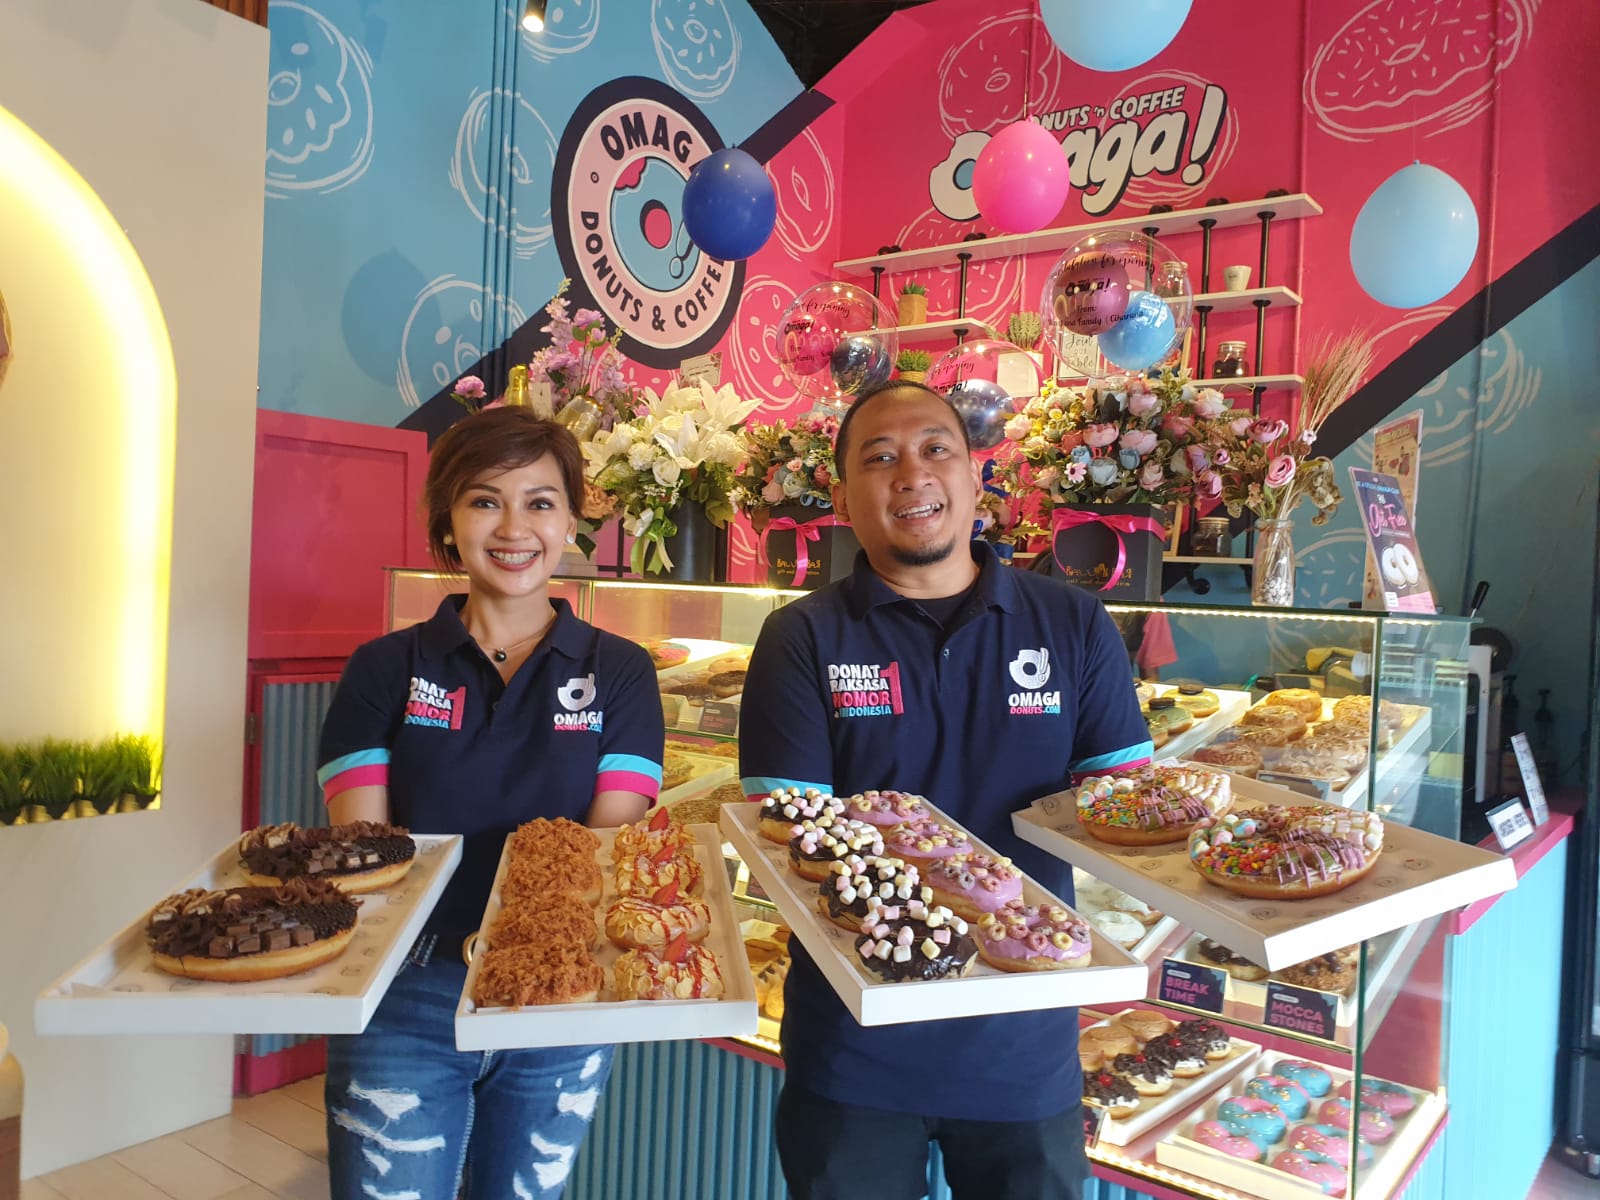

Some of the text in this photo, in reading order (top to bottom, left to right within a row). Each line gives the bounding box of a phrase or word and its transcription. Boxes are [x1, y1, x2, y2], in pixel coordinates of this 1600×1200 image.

[1109, 86, 1186, 120] COFFEE
[600, 111, 701, 174] OMAG
[580, 210, 643, 322] DONUTS
[651, 305, 666, 332] &
[827, 664, 880, 679] DONAT
[829, 678, 889, 692] RAKSASA
[832, 661, 904, 714] NOMOR 1
[446, 686, 466, 730] 1
[1008, 691, 1060, 707] OMAGA
[1165, 987, 1196, 1003] TIME
[1166, 976, 1209, 995] BREAK
[1272, 1001, 1323, 1022] MOCCA
[1270, 1013, 1325, 1034] STONES
